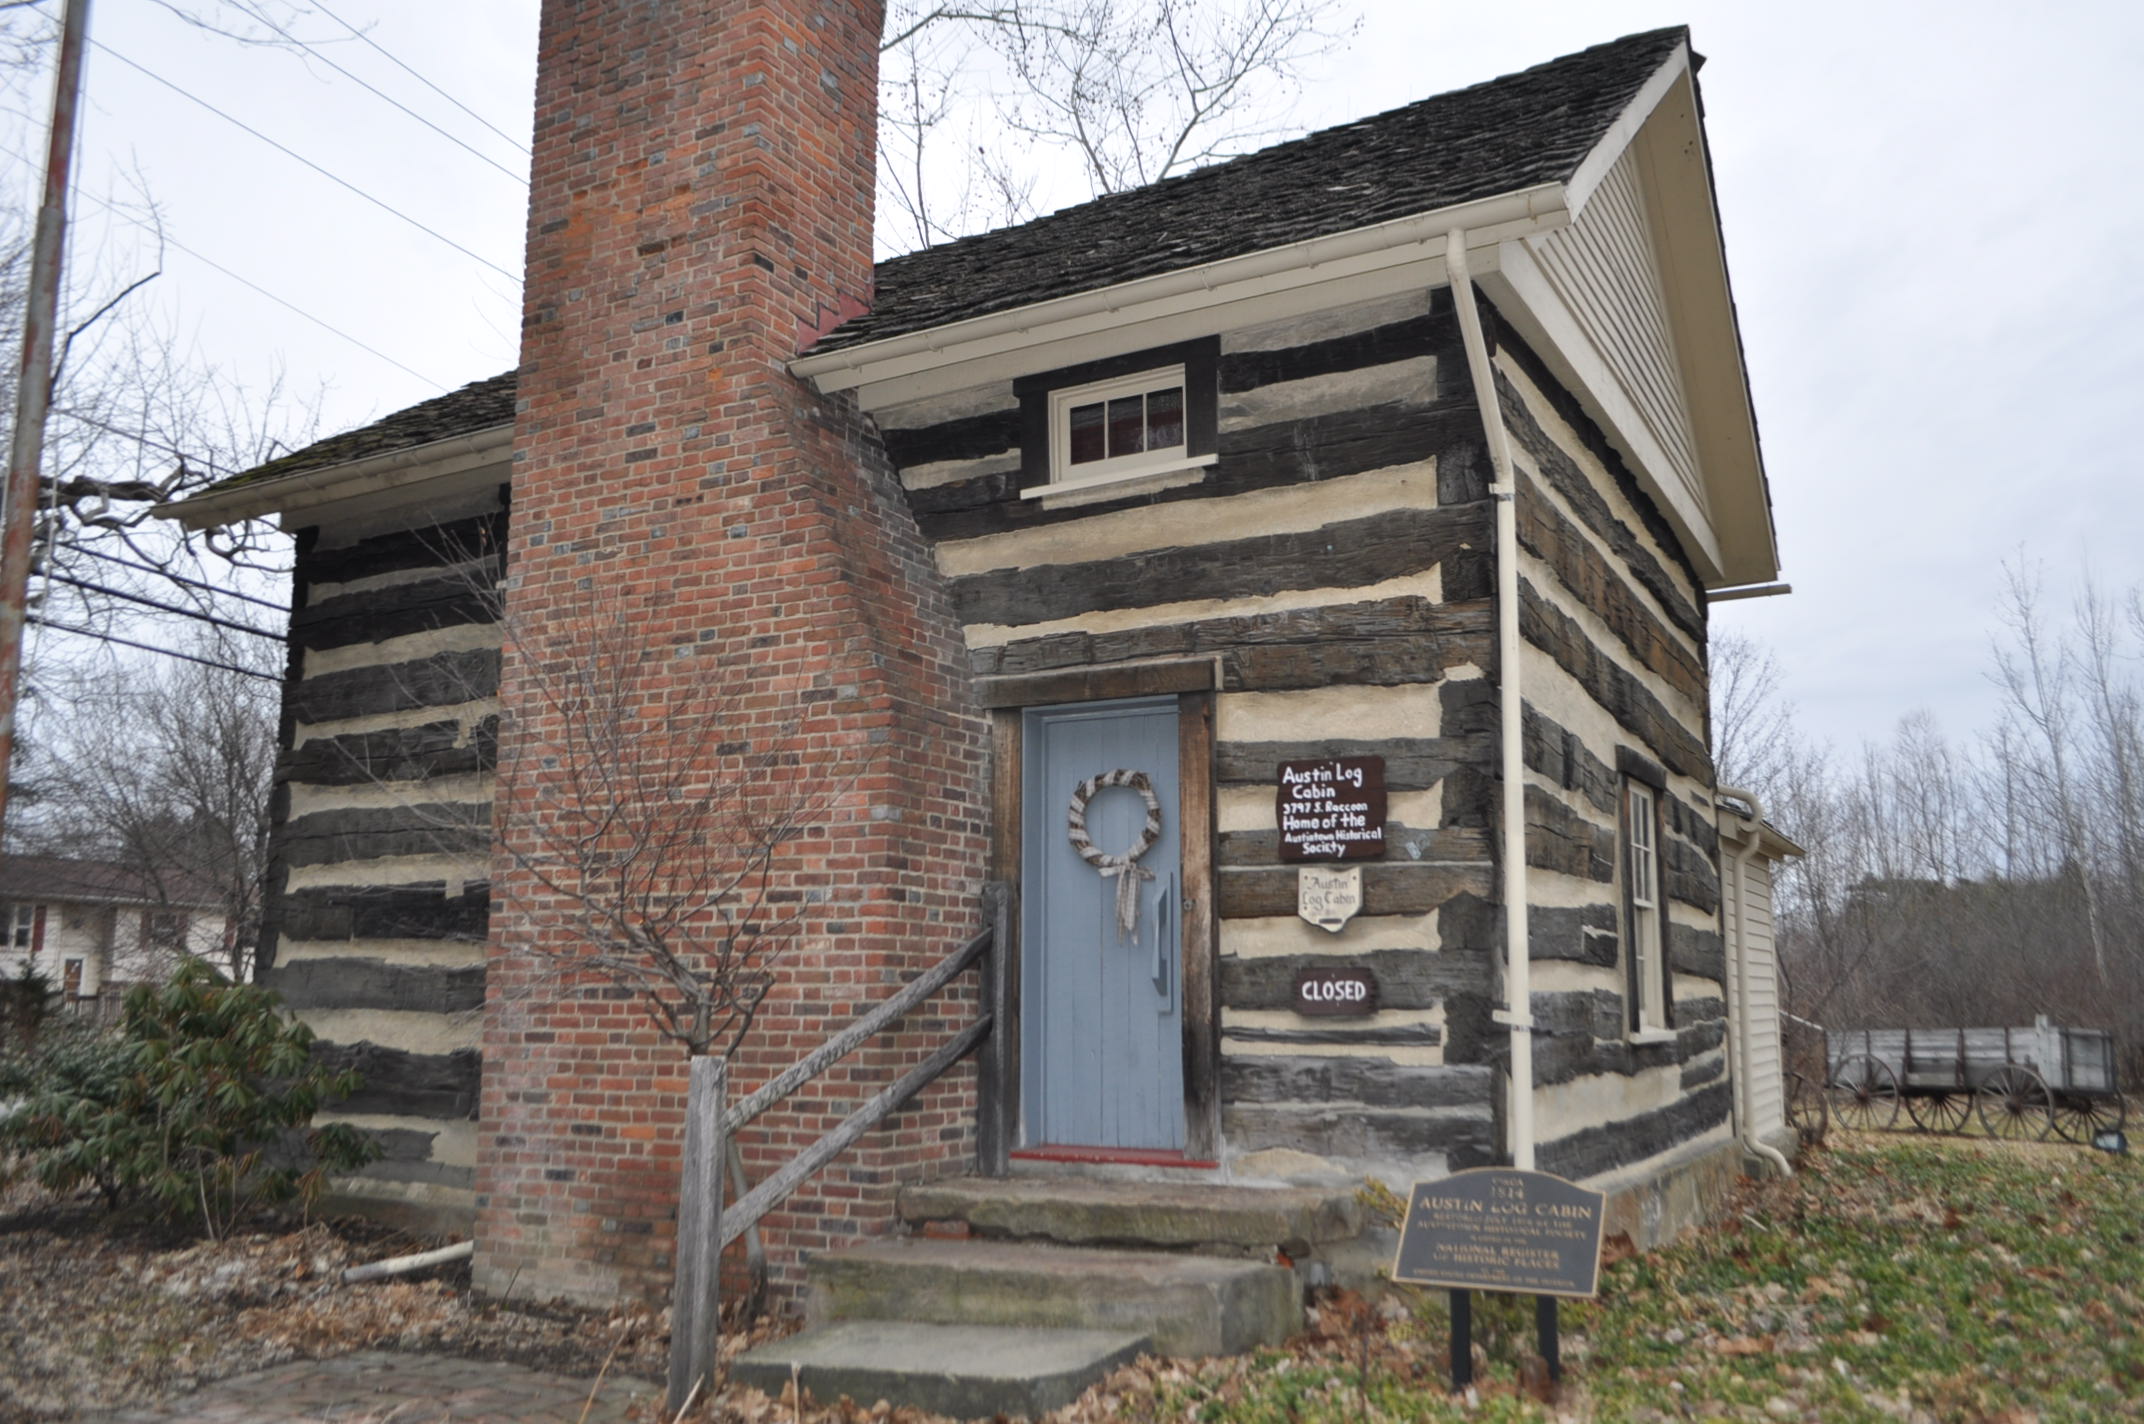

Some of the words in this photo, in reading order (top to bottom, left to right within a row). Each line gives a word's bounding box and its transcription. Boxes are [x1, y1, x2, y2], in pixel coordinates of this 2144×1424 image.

[1282, 766, 1332, 783] Austin
[1336, 762, 1362, 787] Log
[1292, 783, 1336, 799] Cabin
[1283, 802, 1311, 815] 3797
[1325, 801, 1368, 812] Raccoon
[1283, 815, 1320, 831] Home
[1322, 813, 1337, 829] of
[1340, 812, 1366, 827] the
[1285, 831, 1334, 843] Austintown
[1335, 826, 1382, 840] Historical
[1302, 841, 1346, 858] Society
[1307, 876, 1348, 889] Austin
[1303, 891, 1324, 911] Log
[1324, 890, 1356, 904] Cabin
[1302, 980, 1366, 1001] CLOSED
[1419, 1197, 1483, 1213] AUSTIN
[1491, 1202, 1528, 1215] LOG
[1535, 1203, 1592, 1220] CABIN
[1436, 1243, 1496, 1256] NATIONAL
[1501, 1246, 1559, 1261] REGISTER
[1454, 1254, 1509, 1267] HISTORIC
